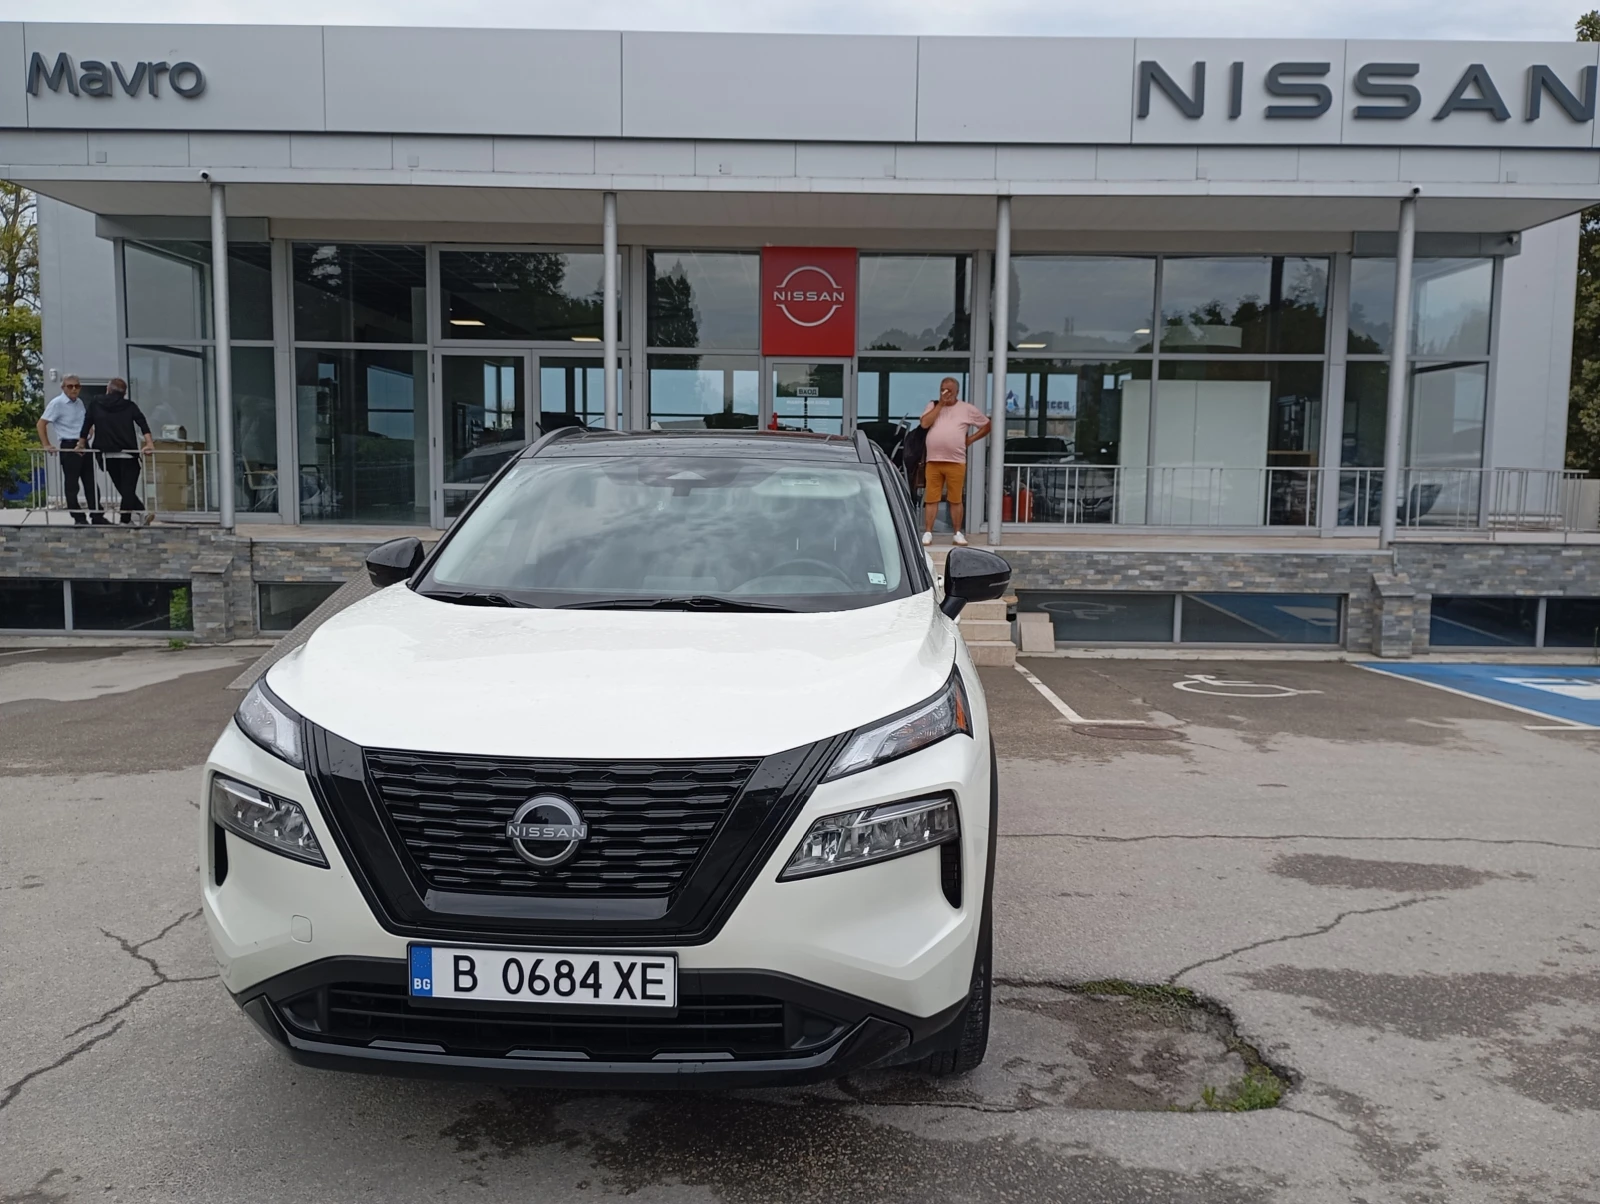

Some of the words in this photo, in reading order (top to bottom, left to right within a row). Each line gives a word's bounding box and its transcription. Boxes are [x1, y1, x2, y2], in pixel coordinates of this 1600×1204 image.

[27, 52, 206, 98] Mavro
[1138, 61, 1597, 122] NISSAN
[773, 291, 845, 302] NISSAN
[798, 388, 817, 396] ВХОД
[508, 825, 585, 838] NISSAN
[414, 978, 431, 990] BG
[453, 954, 478, 993] B
[502, 957, 602, 999] 0684
[613, 961, 666, 1001] XE
